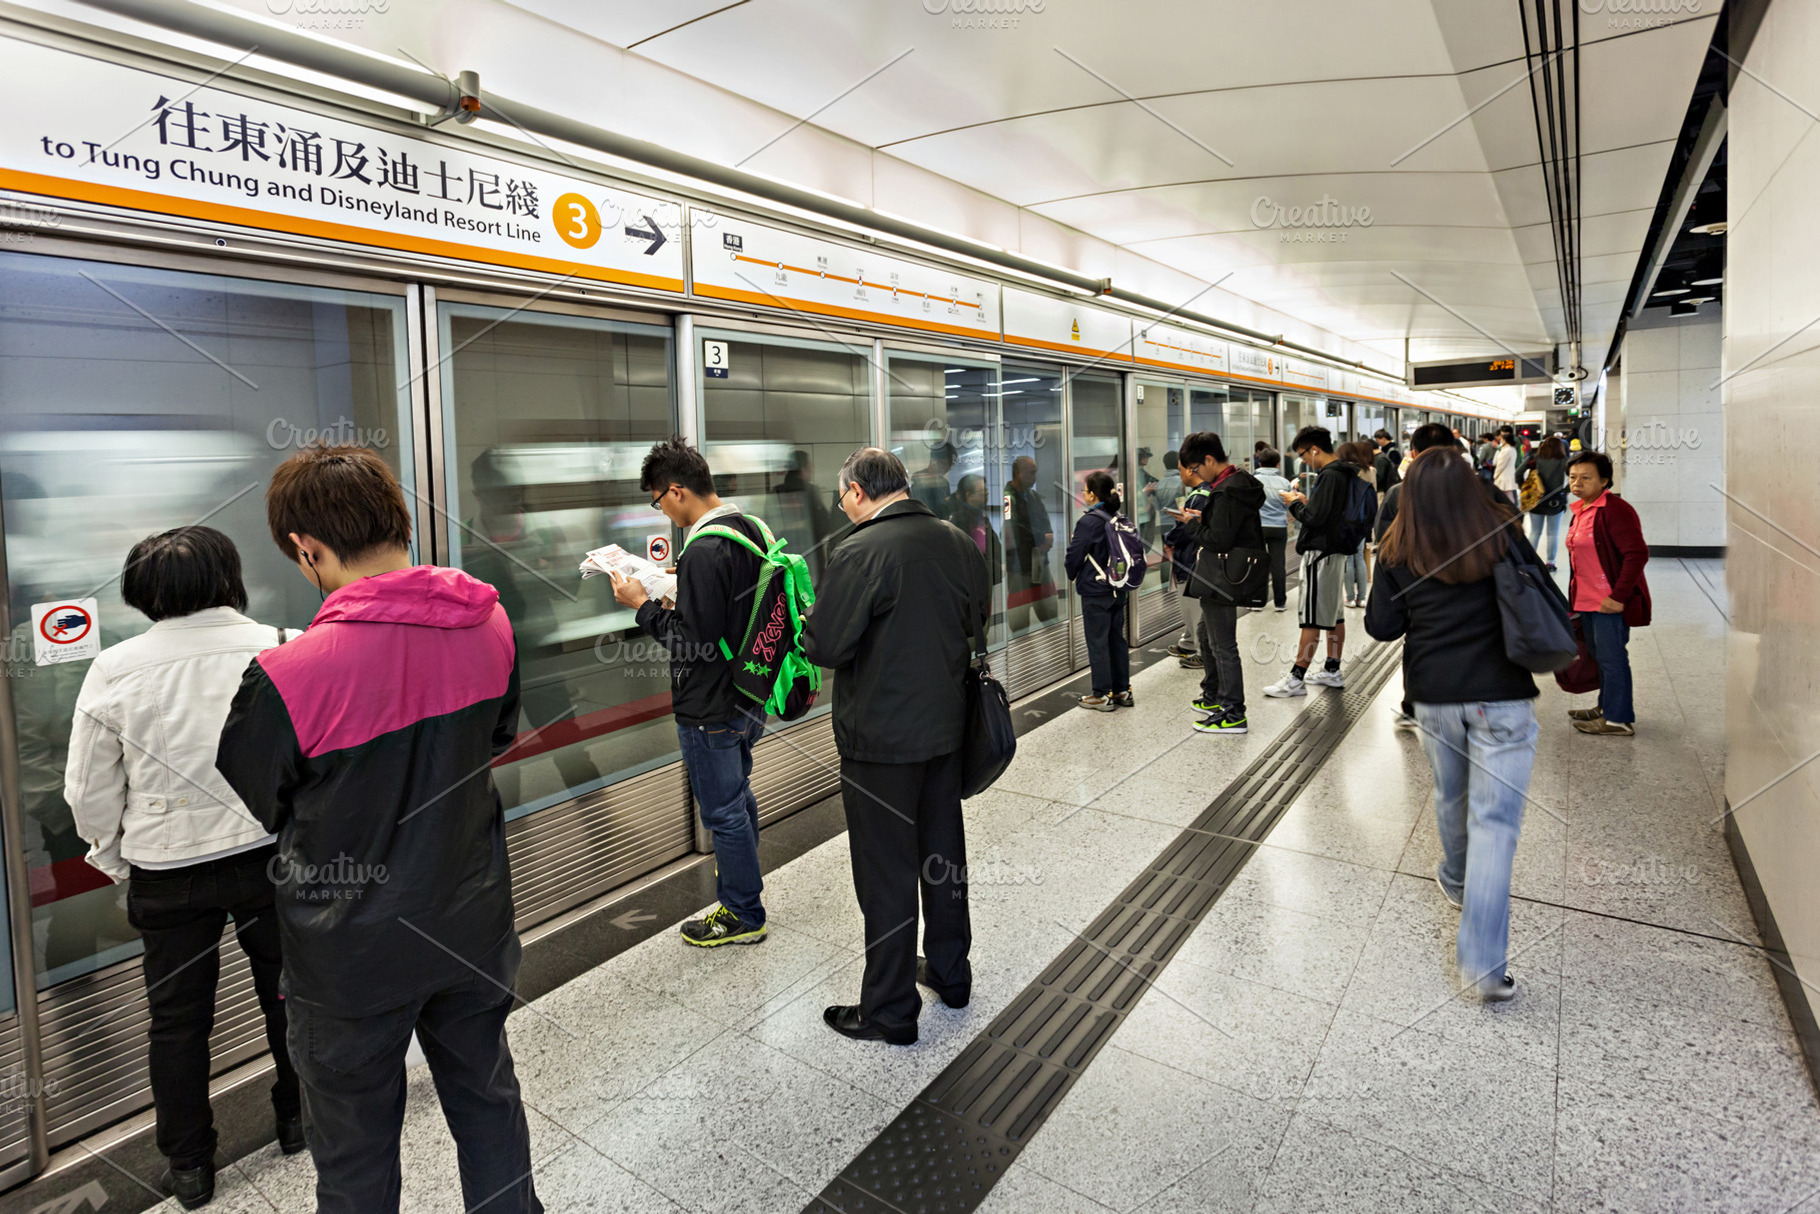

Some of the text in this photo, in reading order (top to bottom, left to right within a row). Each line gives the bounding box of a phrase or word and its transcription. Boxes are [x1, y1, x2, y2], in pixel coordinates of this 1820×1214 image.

[40, 136, 541, 243] to Tung Chung and Disneyland Resort Line
[567, 202, 588, 239] 3
[712, 345, 721, 365] 3
